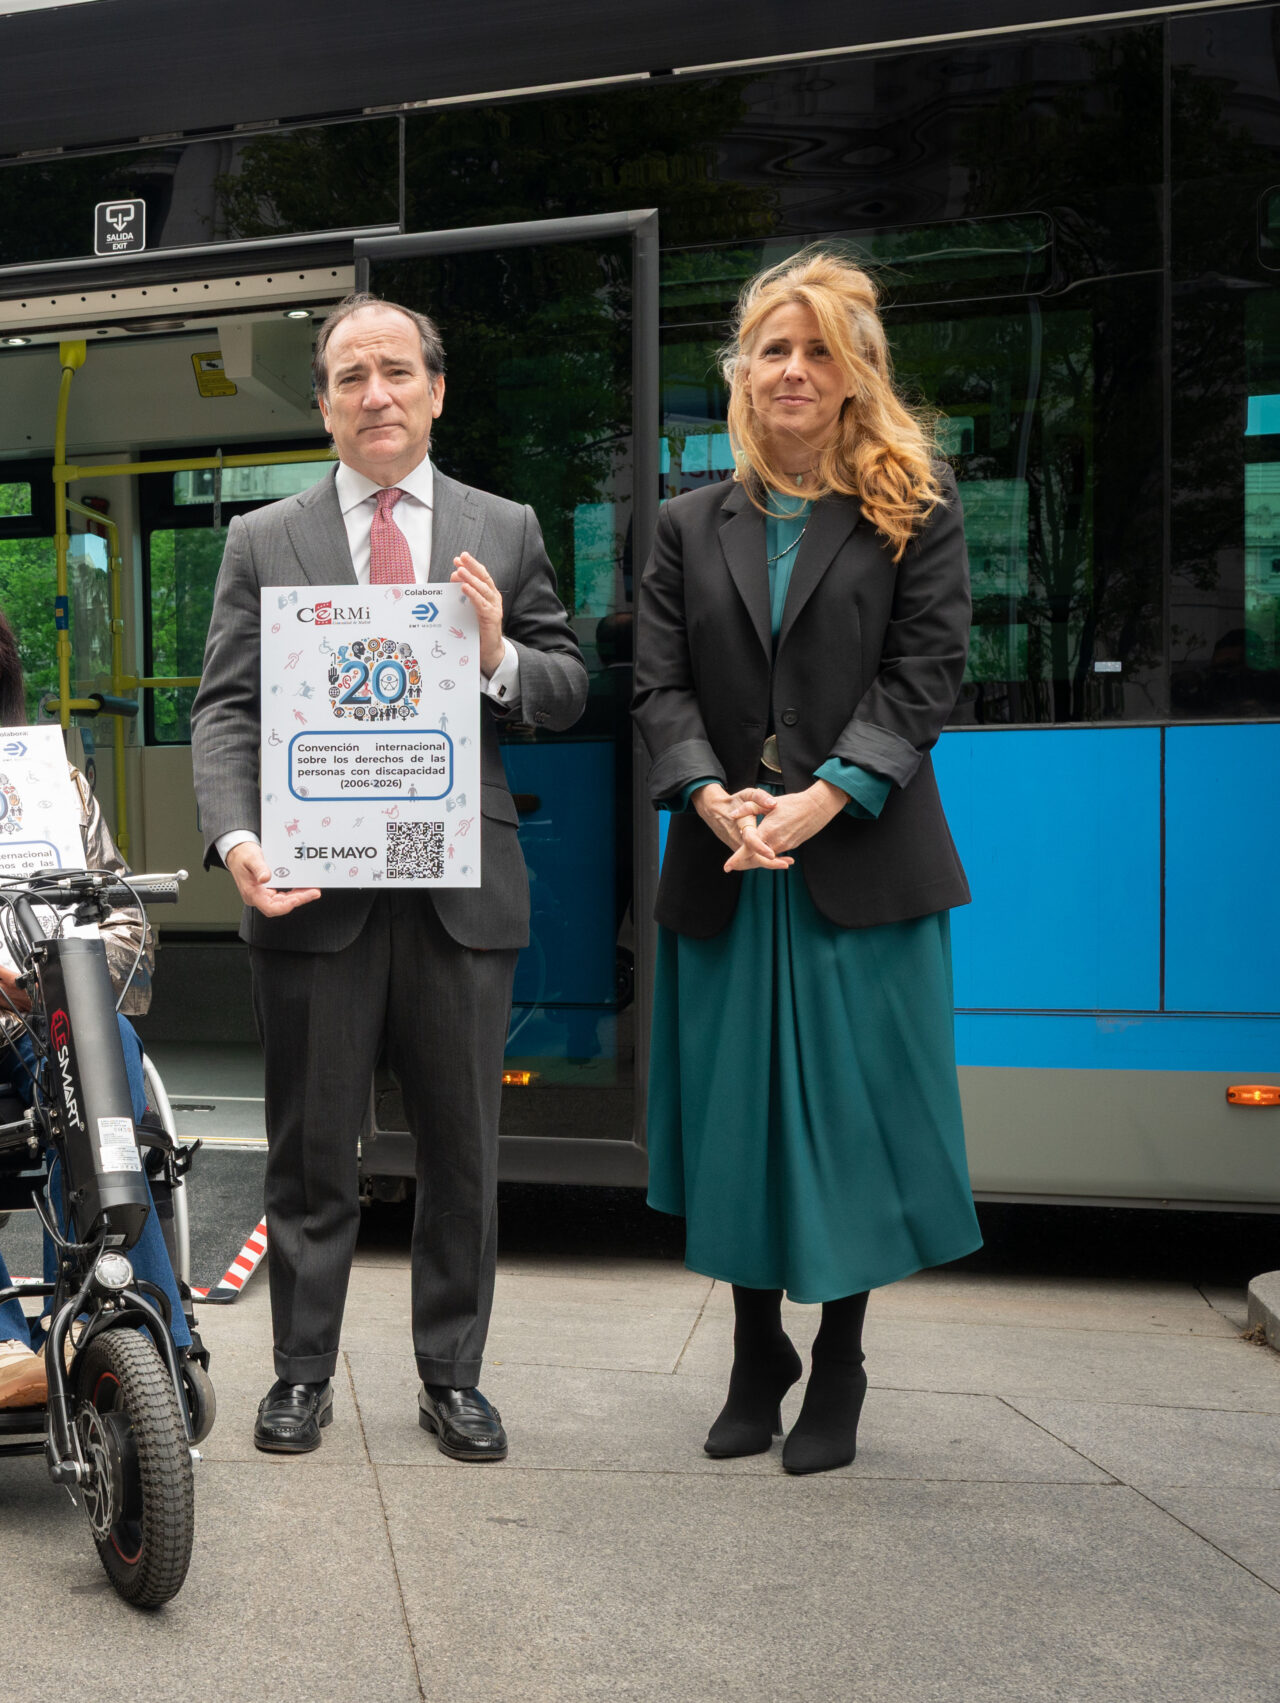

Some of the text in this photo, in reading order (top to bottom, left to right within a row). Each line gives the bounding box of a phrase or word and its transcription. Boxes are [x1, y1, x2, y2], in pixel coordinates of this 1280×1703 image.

[106, 232, 134, 242] SALIDA
[112, 242, 127, 250] EXIT
[404, 588, 443, 596] Colabora:
[339, 660, 407, 705] 20
[298, 742, 446, 753] Convención internacional
[298, 754, 446, 764] sobre los derechos de las
[298, 766, 446, 778] personas con discapacidad
[340, 779, 402, 789] (2006-2026)
[294, 846, 378, 859] 3 DE MAYO
[40, 859, 55, 867] las
